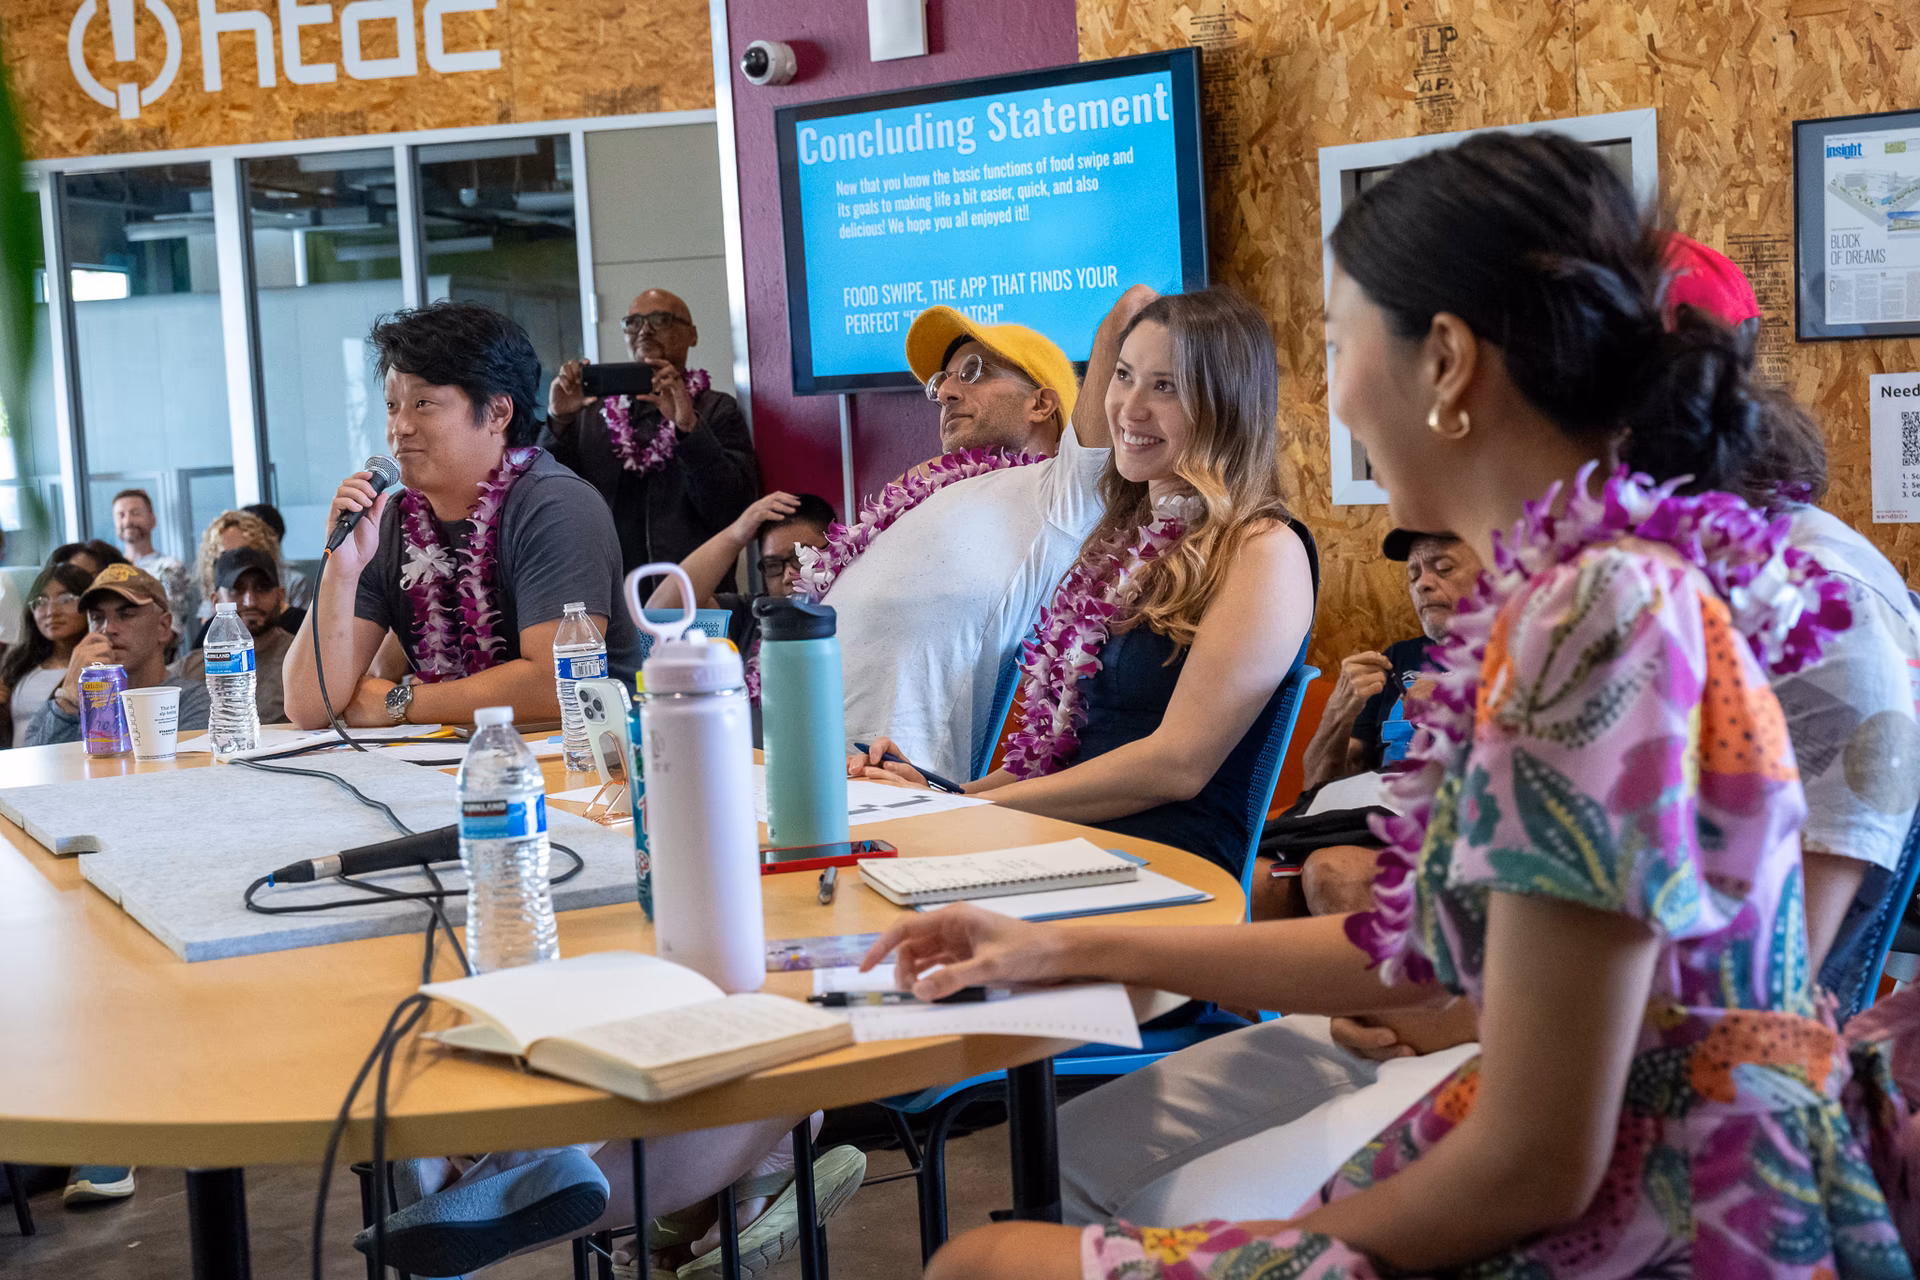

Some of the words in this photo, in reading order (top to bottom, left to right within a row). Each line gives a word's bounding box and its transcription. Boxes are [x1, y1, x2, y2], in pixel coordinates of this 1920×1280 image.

[799, 112, 977, 166] Concluding
[986, 82, 1170, 143] Statement
[1826, 143, 1863, 159] insight
[836, 180, 857, 197] Now
[860, 177, 881, 194] that
[883, 177, 901, 194] you
[903, 173, 931, 189] know
[933, 169, 950, 186] the
[952, 165, 981, 184] basic
[983, 161, 1033, 180] functions
[1036, 157, 1047, 174] of
[1050, 153, 1075, 172] food
[1077, 151, 1110, 171] swipe
[1113, 146, 1134, 165] and
[837, 202, 851, 218] its
[853, 198, 879, 220] goals
[881, 199, 893, 213] to
[894, 194, 933, 212] making
[934, 191, 951, 208] life
[953, 193, 961, 206] a
[962, 188, 979, 205] bit
[980, 184, 1015, 203] easier,
[1017, 179, 1051, 203] quick,
[1053, 176, 1073, 195] and
[1076, 174, 1099, 193] also
[839, 219, 887, 240] delicious!
[888, 217, 905, 235] We
[906, 215, 932, 235] hope
[934, 215, 953, 232] you
[955, 210, 968, 228] all
[971, 206, 1013, 229] enjoyed
[1014, 204, 1031, 222] it!!
[1830, 233, 1861, 249] BLOCK
[1830, 250, 1843, 266] OF
[1845, 248, 1886, 265] DREAMS
[843, 285, 879, 308] FOOD
[881, 281, 928, 305] SWIPE,
[930, 278, 957, 301] THE
[960, 275, 987, 299] APP
[990, 272, 1026, 297] THAT
[1030, 269, 1073, 293] FINDS
[1075, 265, 1119, 290] YOUR
[845, 311, 900, 335] PERFECT
[1880, 383, 1920, 398] Need
